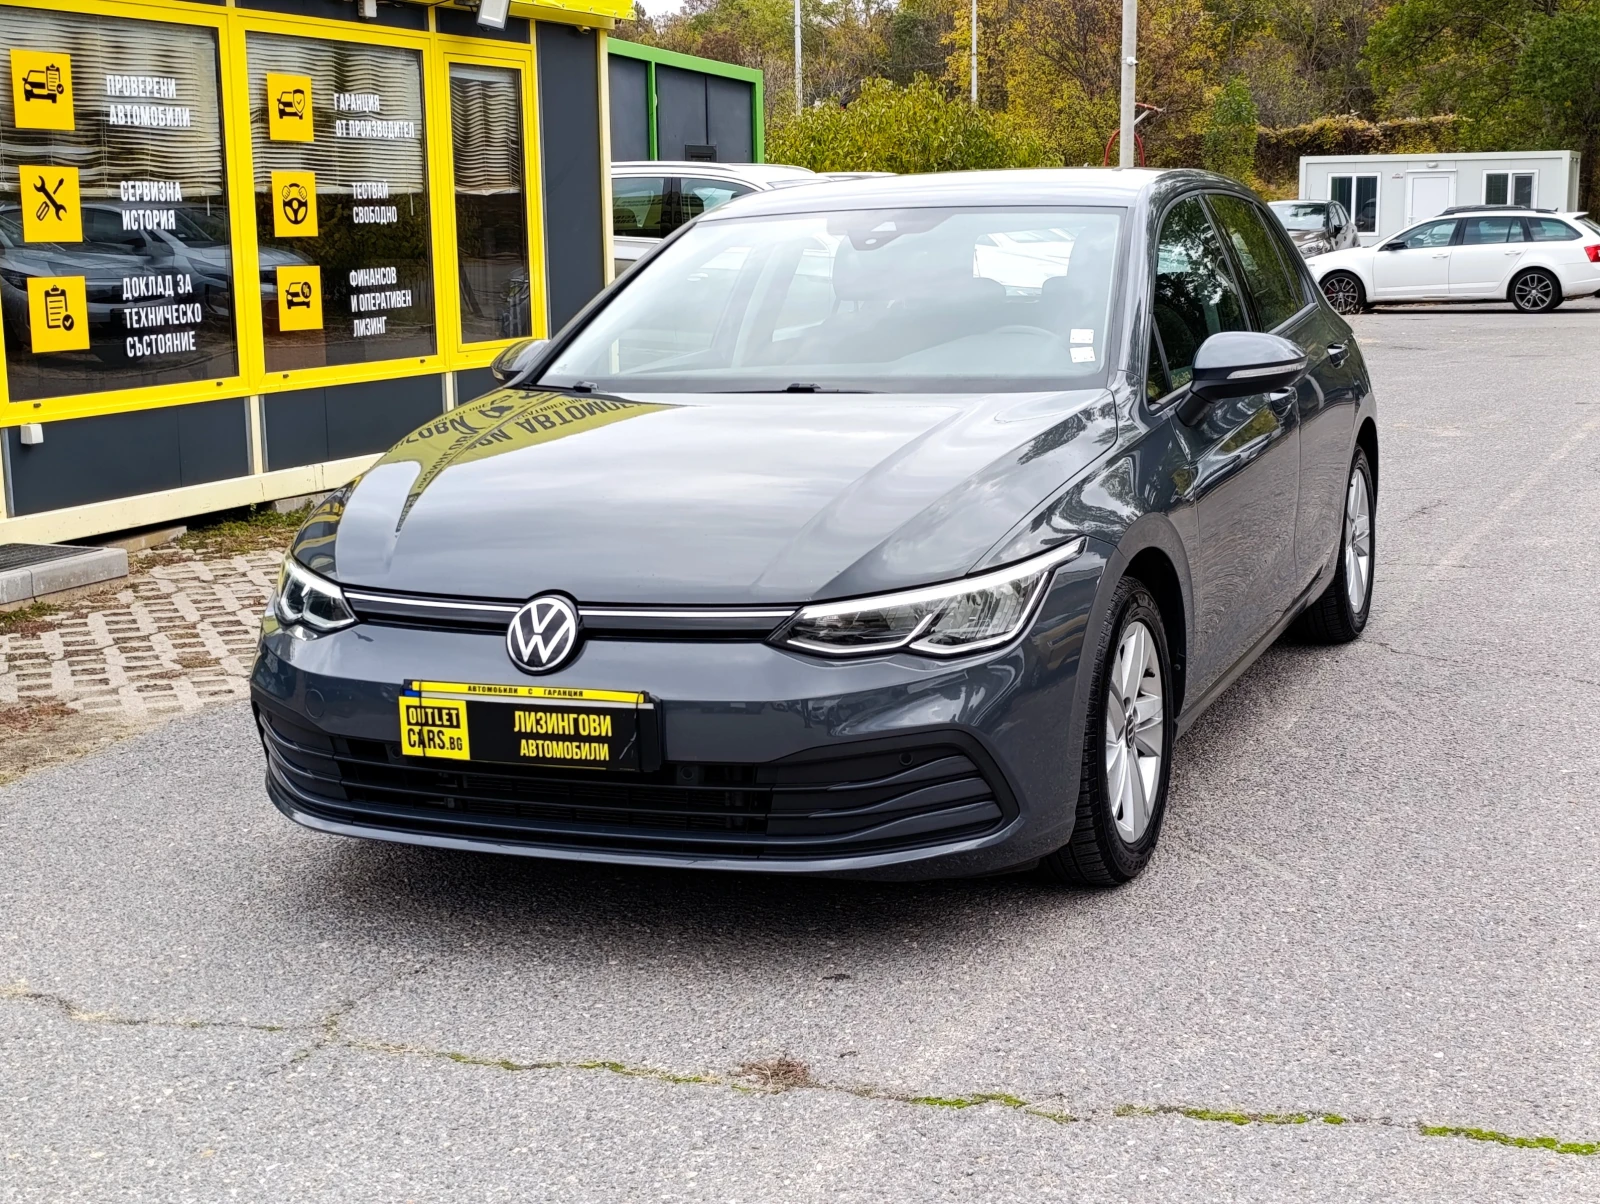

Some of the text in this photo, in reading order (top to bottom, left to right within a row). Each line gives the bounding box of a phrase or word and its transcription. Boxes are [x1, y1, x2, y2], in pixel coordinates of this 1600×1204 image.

[106, 75, 177, 98] ПРОВЕРЕНИ
[333, 93, 380, 113] ГАРАНЦИЯ
[109, 105, 191, 127] АВТОМОБИЛИ
[336, 120, 415, 139] ОТ ПРОИЗВОДИТЕЛ
[120, 180, 182, 202] СЕРВИЗНА
[352, 180, 389, 199] ТЕСТВАЙ
[122, 209, 176, 230] ИСТОРИЯ
[353, 206, 397, 224] СВОБОДНО
[122, 273, 193, 301] ДОКЛАД ЗА
[349, 266, 397, 287] ФИНАНСОВ
[351, 289, 412, 313] И ОПЕРАТИВЕН
[124, 302, 202, 329] ТЕХНИЧЕСКО
[353, 316, 387, 338] ЛИЗИНГ
[126, 331, 197, 358] СЪСТОЯНИЕ
[467, 685, 518, 695] АВТОМОБИЛИ
[543, 689, 584, 698] ГАРАНЦИЯ
[408, 707, 458, 727] OUTLET
[514, 711, 612, 738] ЛИЗИНГОВИ
[520, 738, 609, 761] АВТОМОБИЛИ
